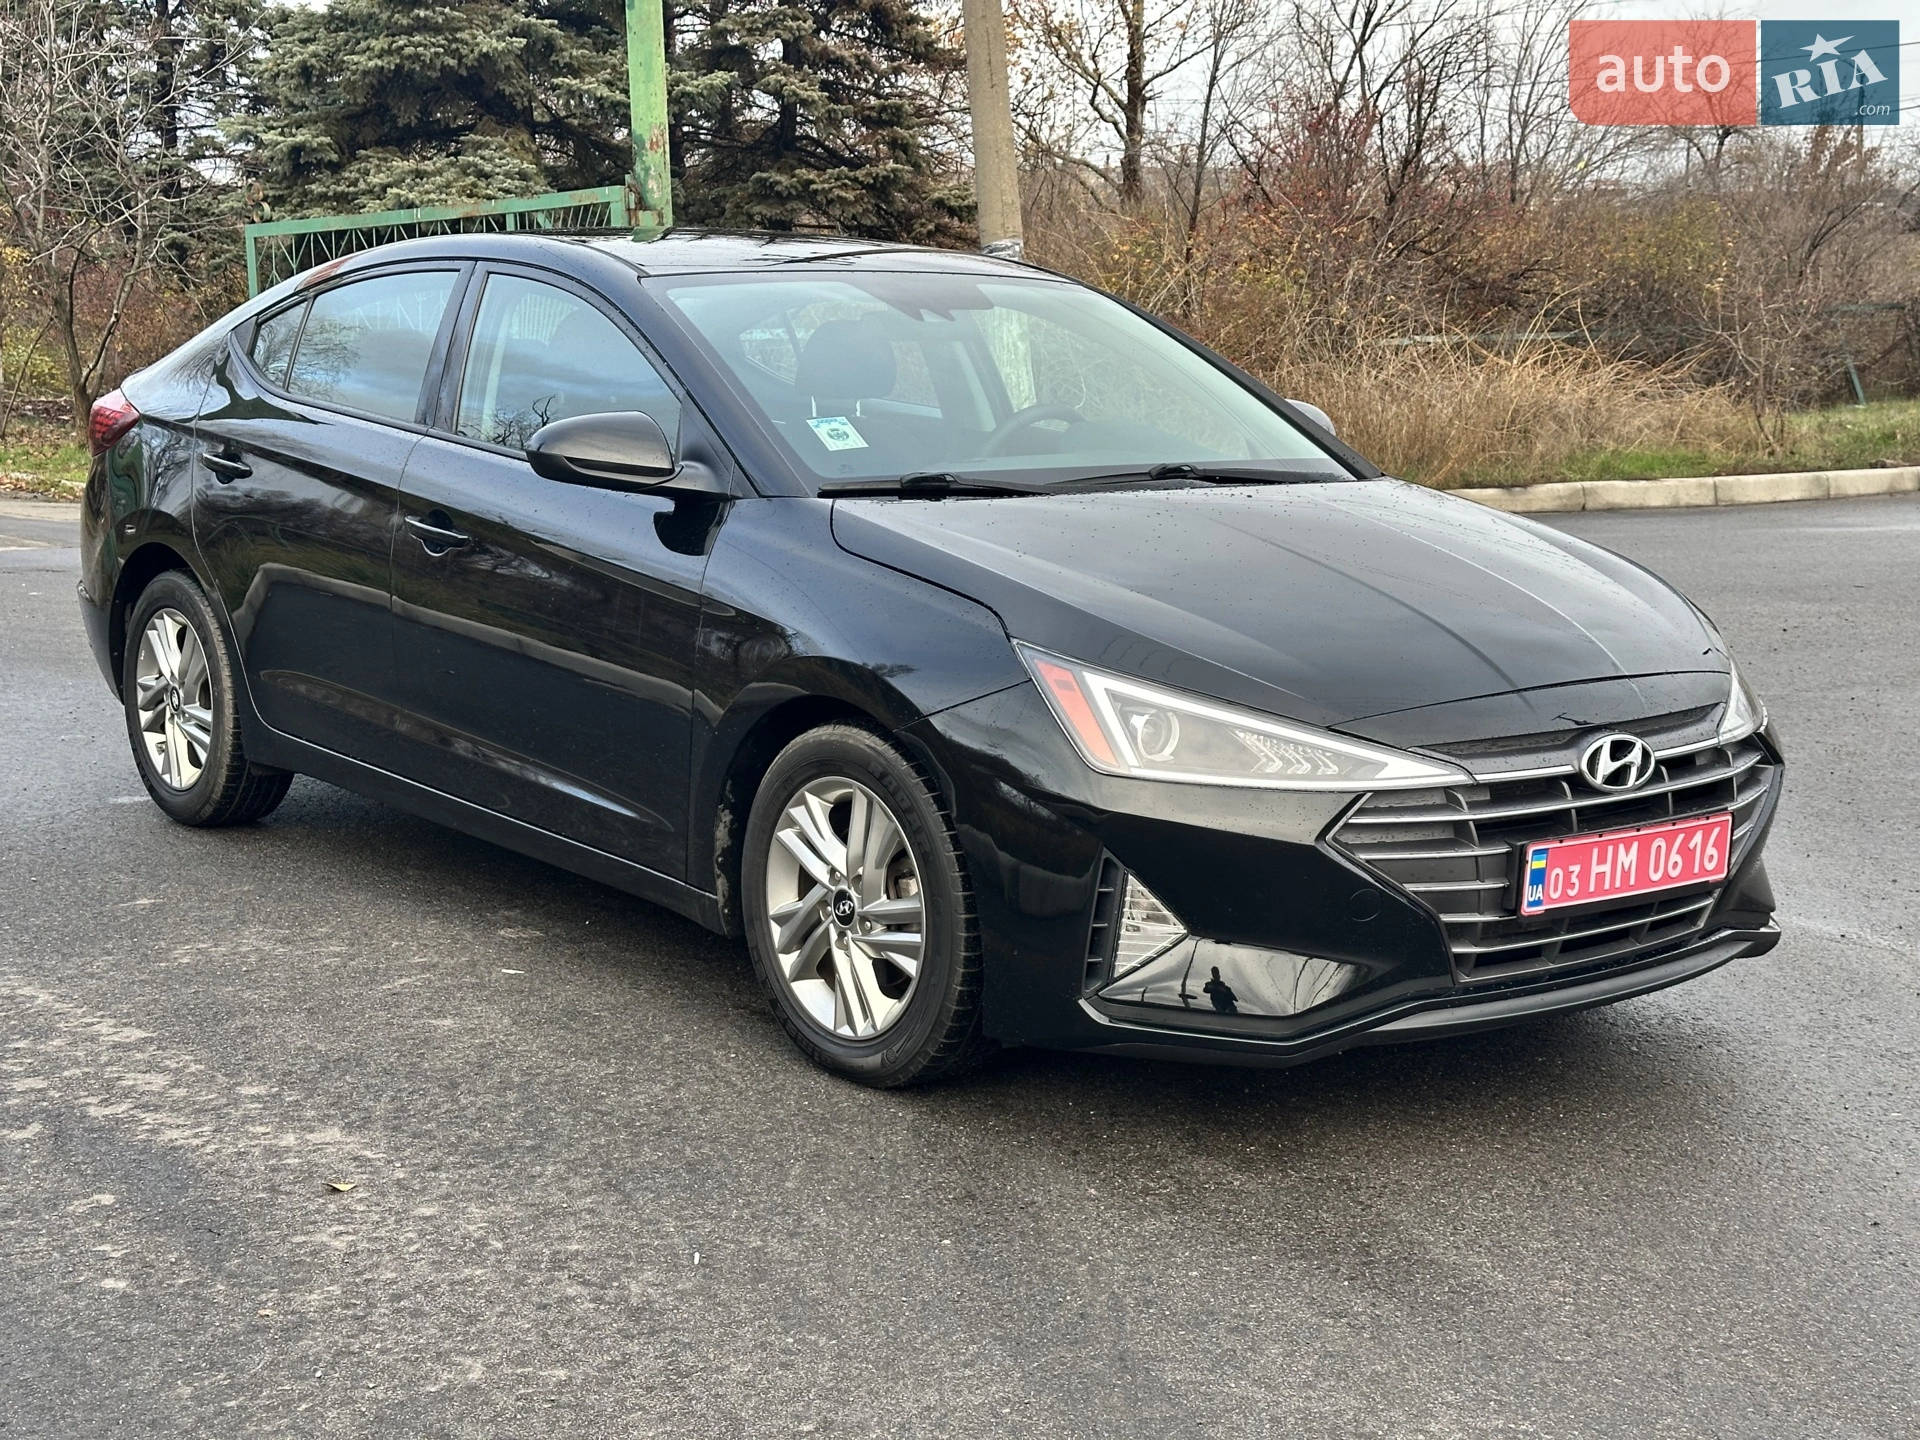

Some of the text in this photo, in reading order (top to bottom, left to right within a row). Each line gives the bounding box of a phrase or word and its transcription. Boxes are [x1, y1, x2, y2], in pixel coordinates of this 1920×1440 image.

[1549, 826, 1722, 900] 03 HM 0616
[1528, 885, 1544, 901] UA
